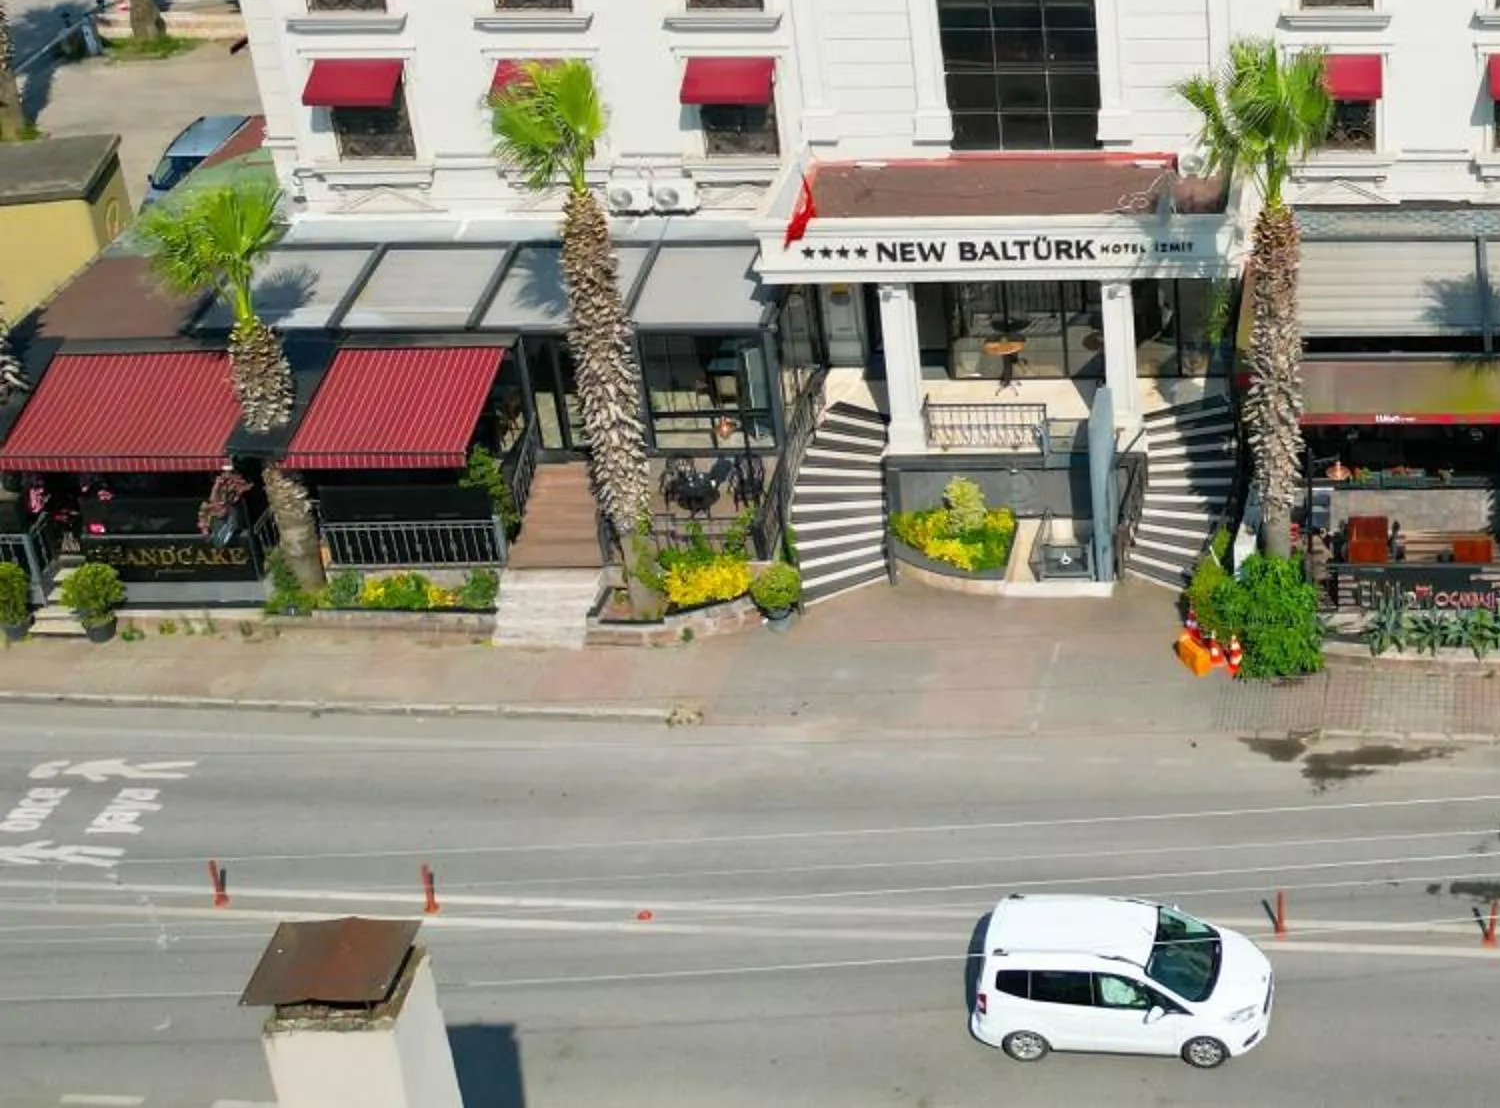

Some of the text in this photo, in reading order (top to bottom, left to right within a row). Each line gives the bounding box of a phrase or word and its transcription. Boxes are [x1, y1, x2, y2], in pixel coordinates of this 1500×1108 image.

[876, 241, 946, 263] NEW
[958, 236, 1097, 262] BALTÜRK
[1100, 243, 1147, 254] HOTEL
